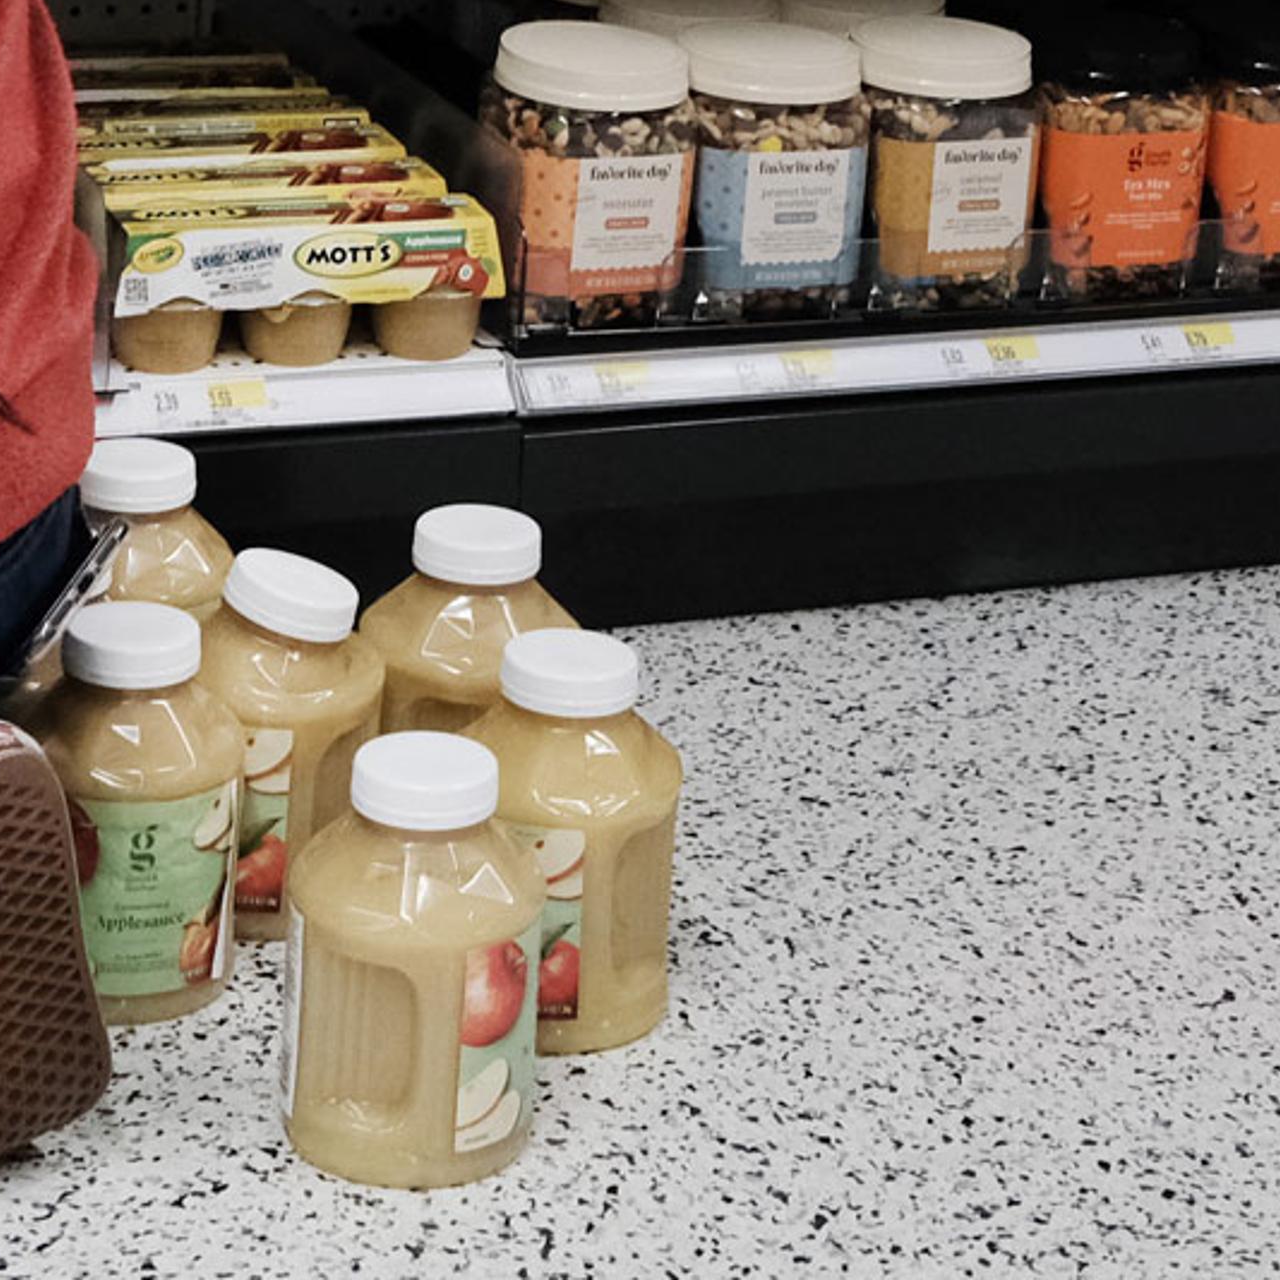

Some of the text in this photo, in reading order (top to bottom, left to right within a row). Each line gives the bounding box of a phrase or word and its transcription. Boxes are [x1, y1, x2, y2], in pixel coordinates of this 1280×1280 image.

[590, 162, 673, 183] favorite day
[305, 244, 392, 263] MOTT'S
[96, 912, 185, 933] Applesauce
